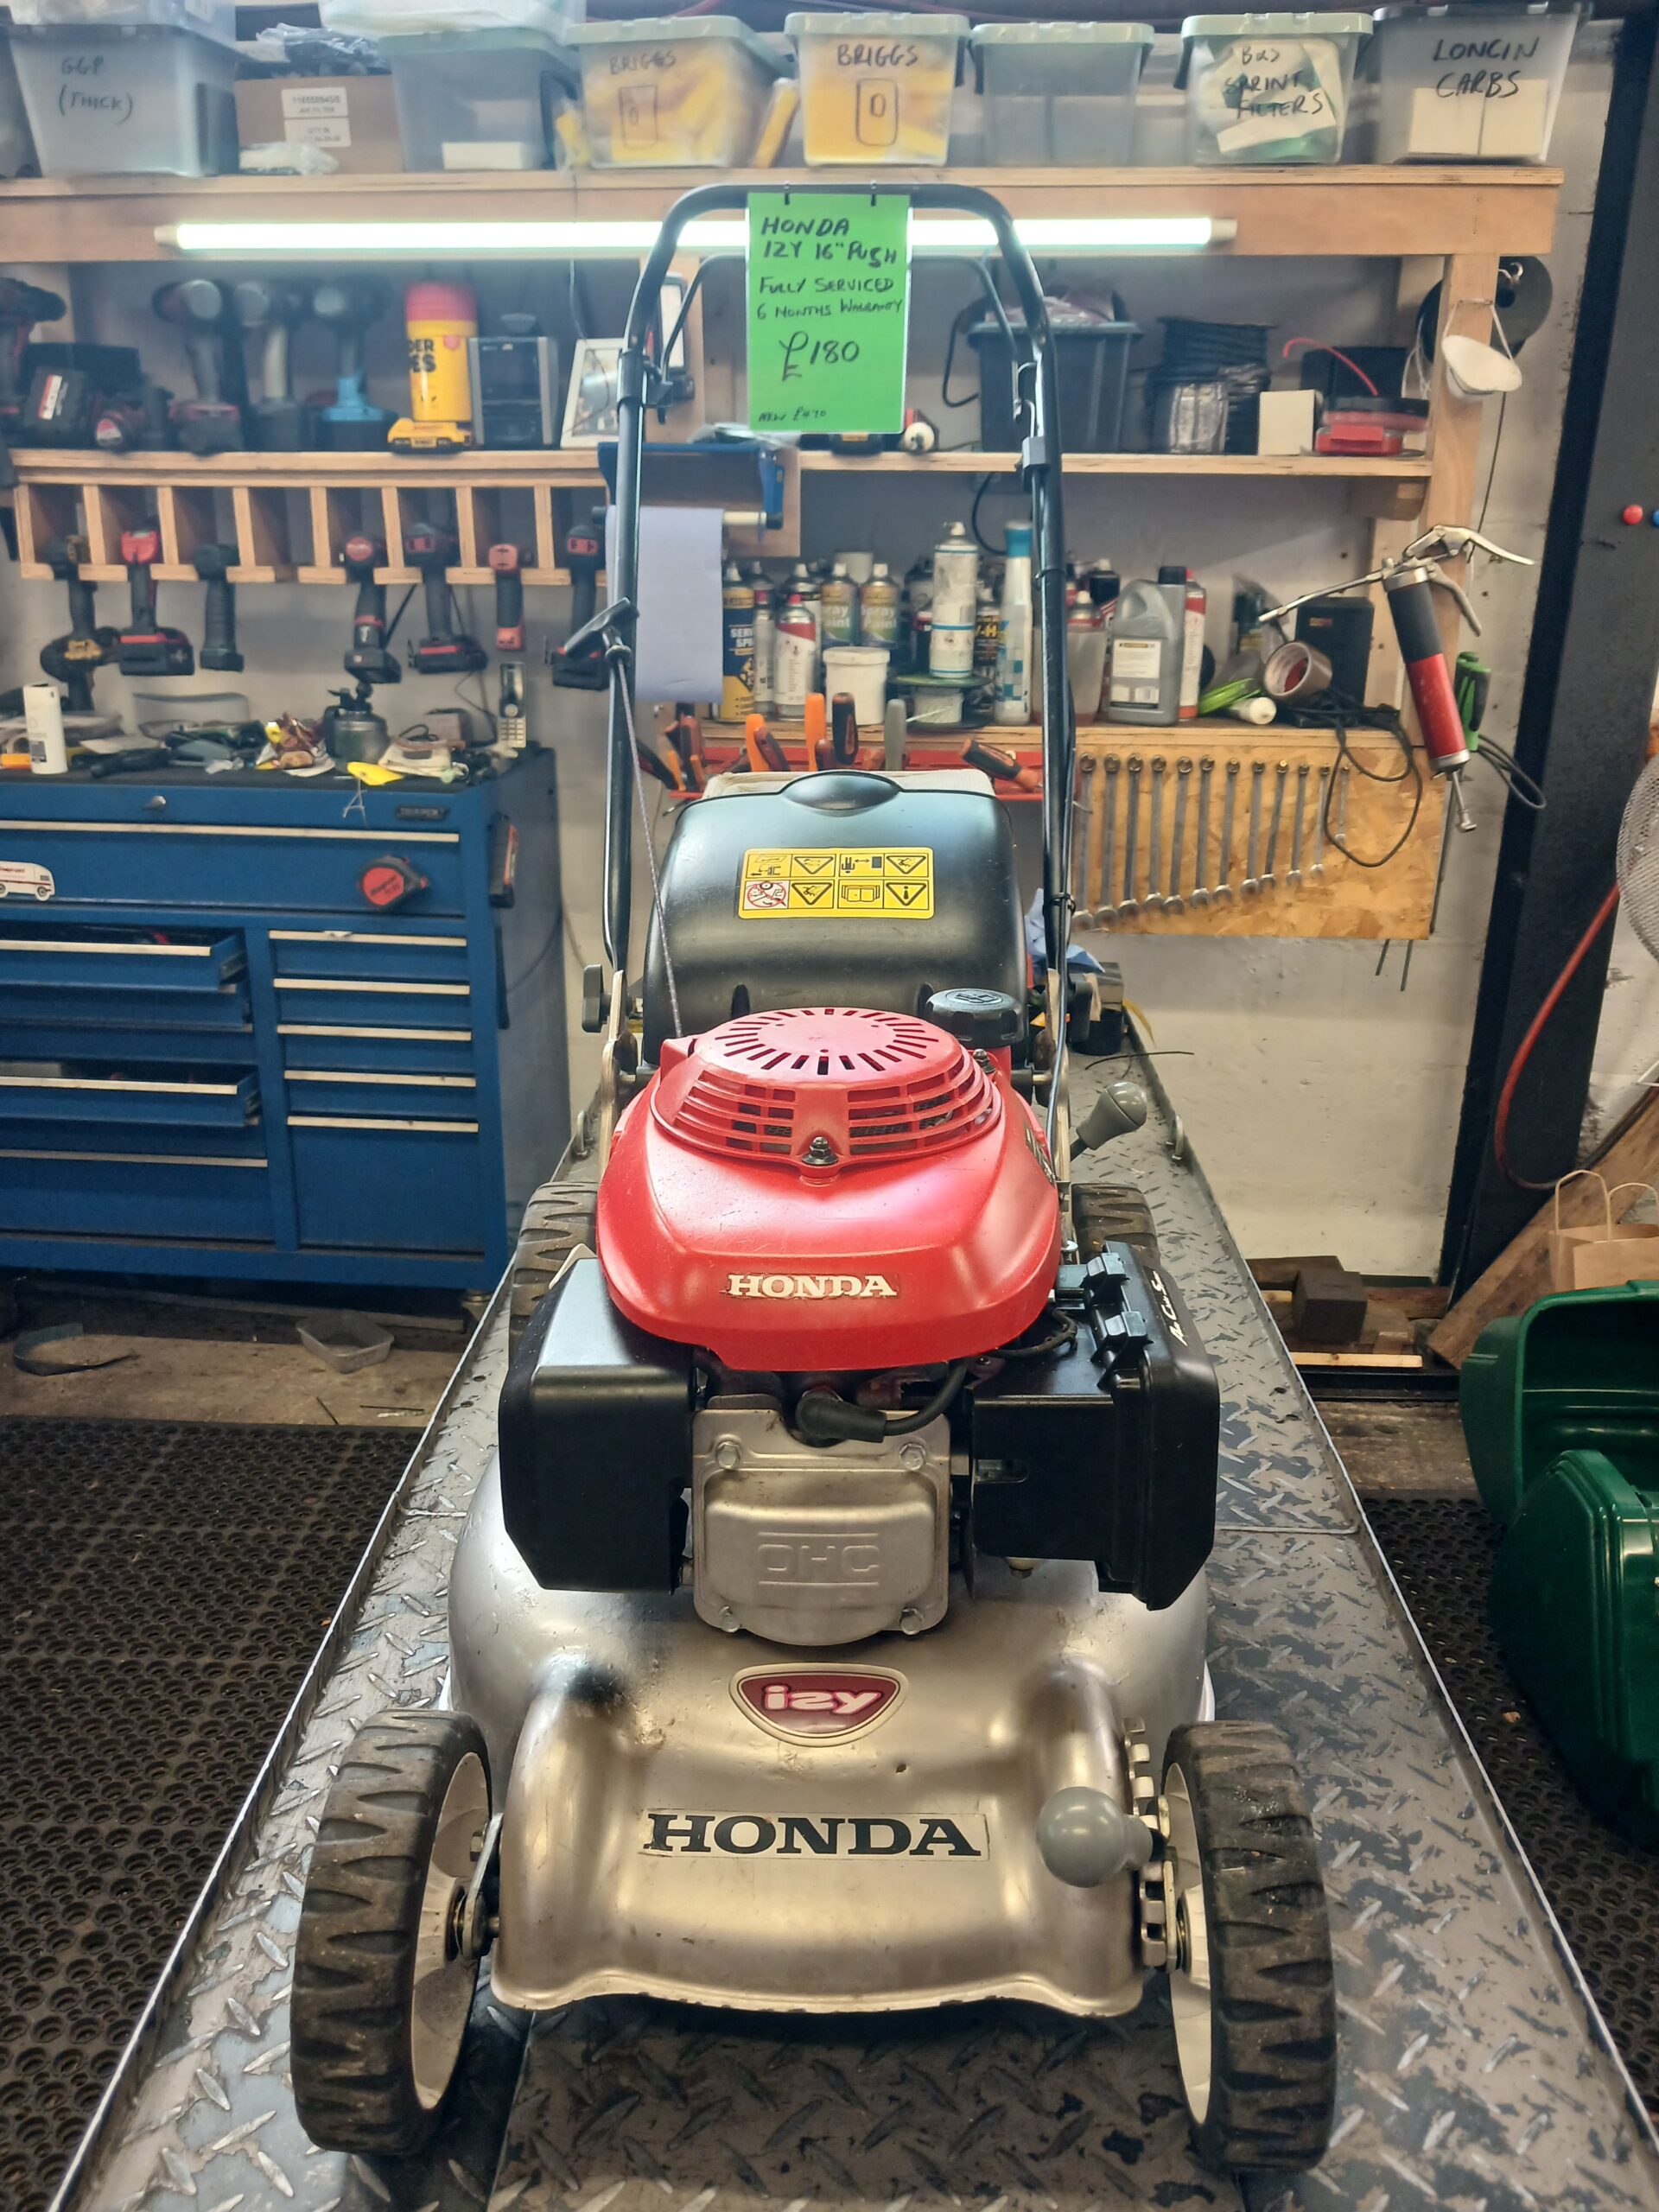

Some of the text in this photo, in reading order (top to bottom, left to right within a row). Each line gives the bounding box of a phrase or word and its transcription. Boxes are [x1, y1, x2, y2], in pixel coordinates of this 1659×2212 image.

[837, 44, 919, 67] BRIGGS
[1433, 37, 1540, 61] LONCIN
[609, 51, 677, 75] BRIGGS
[1223, 69, 1303, 94] SPRINT
[1436, 70, 1521, 98] CARBS
[1236, 92, 1323, 118] FILTERS
[760, 217, 849, 237] HONDA
[847, 240, 897, 268] PUSH
[815, 277, 894, 293] SERVICED
[757, 303, 766, 320] 6
[775, 305, 832, 318] MONTHS
[779, 330, 860, 382] £180
[727, 1274, 897, 1299] HONDA
[758, 1543, 880, 1573] OHC
[766, 1684, 882, 1715] izy
[643, 1813, 982, 1857] HONDA
